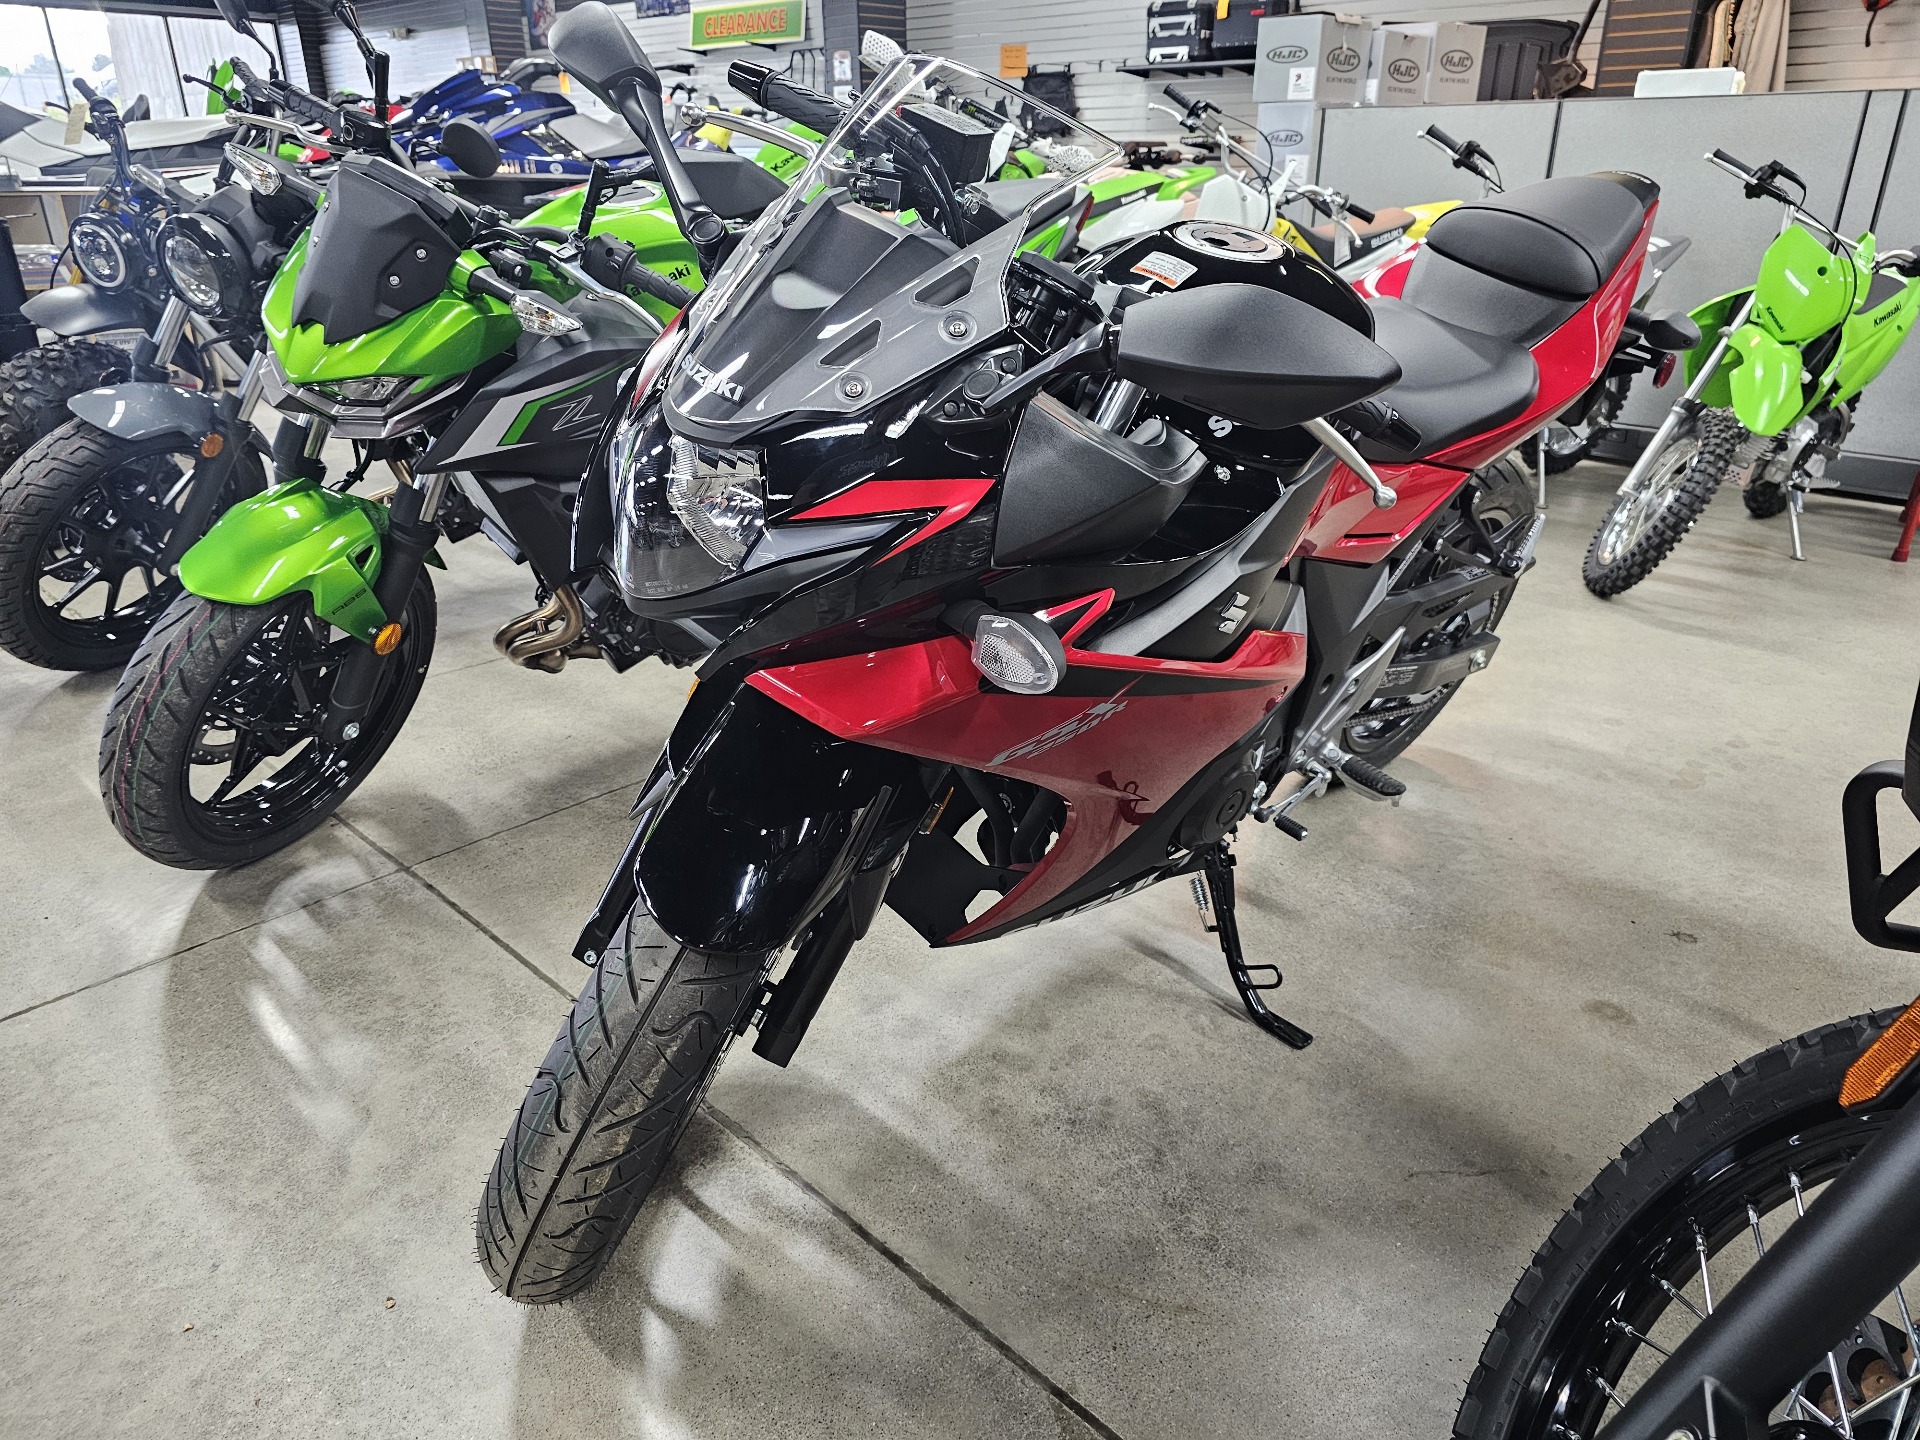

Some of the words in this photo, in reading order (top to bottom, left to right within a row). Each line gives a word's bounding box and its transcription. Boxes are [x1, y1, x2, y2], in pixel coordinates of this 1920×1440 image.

[705, 7, 787, 38] CLEARANCE
[1330, 52, 1357, 67] HJC
[1391, 64, 1418, 79] HJC
[1443, 55, 1470, 69] HJC
[1766, 305, 1786, 333] Kawasaki
[1873, 300, 1902, 328] Kawasaki
[331, 588, 367, 616] ABS
